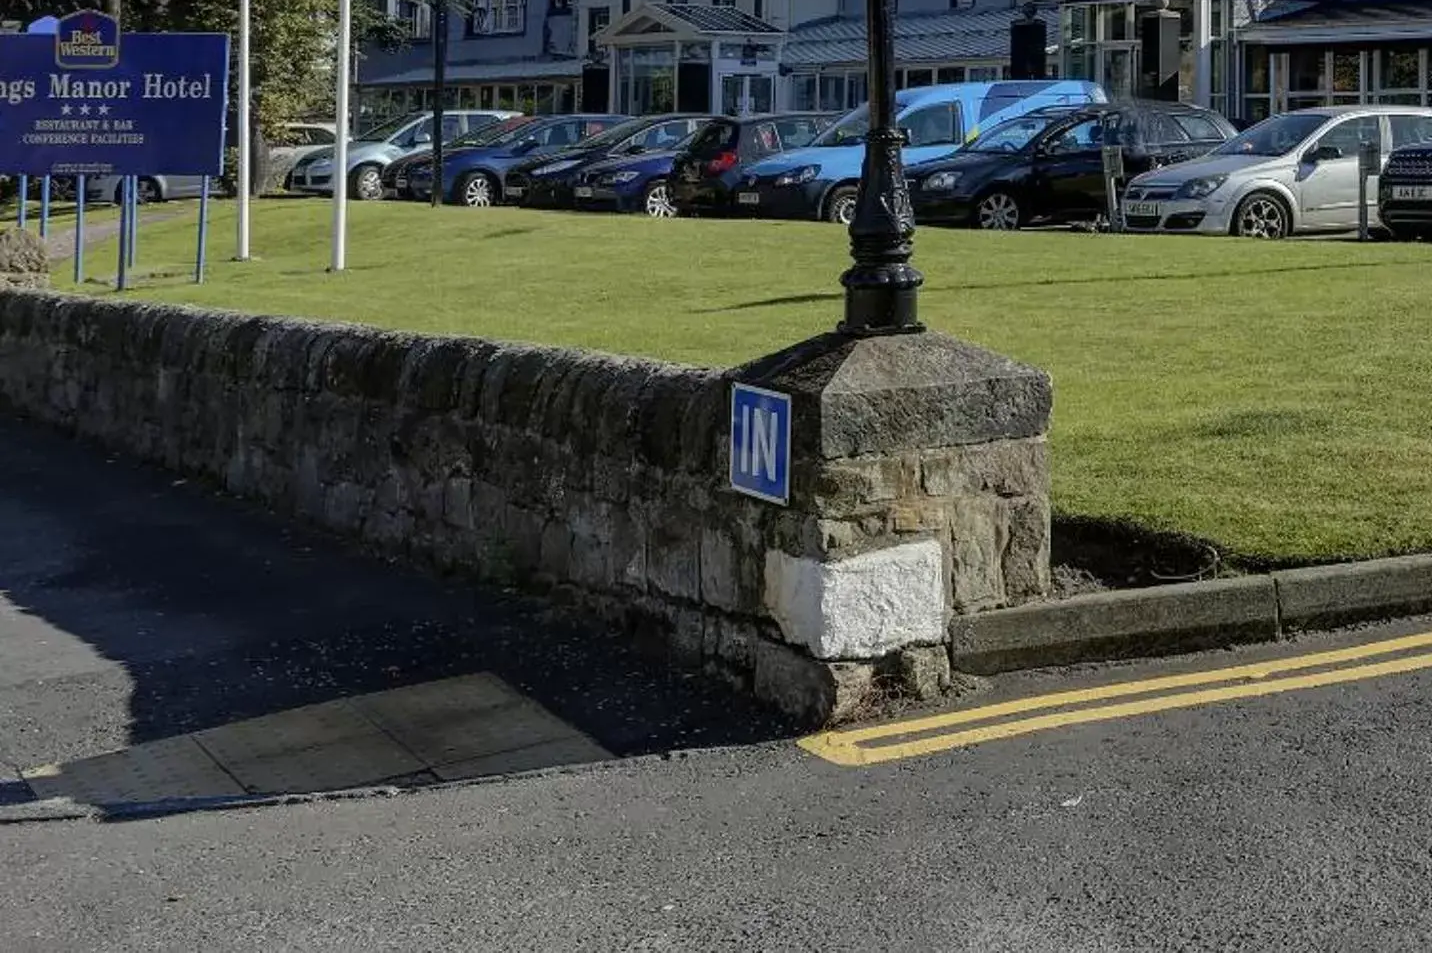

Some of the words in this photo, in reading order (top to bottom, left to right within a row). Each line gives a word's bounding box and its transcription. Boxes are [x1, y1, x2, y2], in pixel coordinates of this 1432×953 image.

[72, 30, 102, 45] Best
[60, 42, 116, 56] Western
[48, 73, 131, 98] Manor
[143, 73, 212, 98] Hotel
[35, 119, 100, 131] RESTAURANT
[114, 120, 134, 130] BAR
[22, 133, 89, 145] CONFERENCE
[91, 133, 144, 144] FACILITIES
[740, 404, 778, 482] IN
